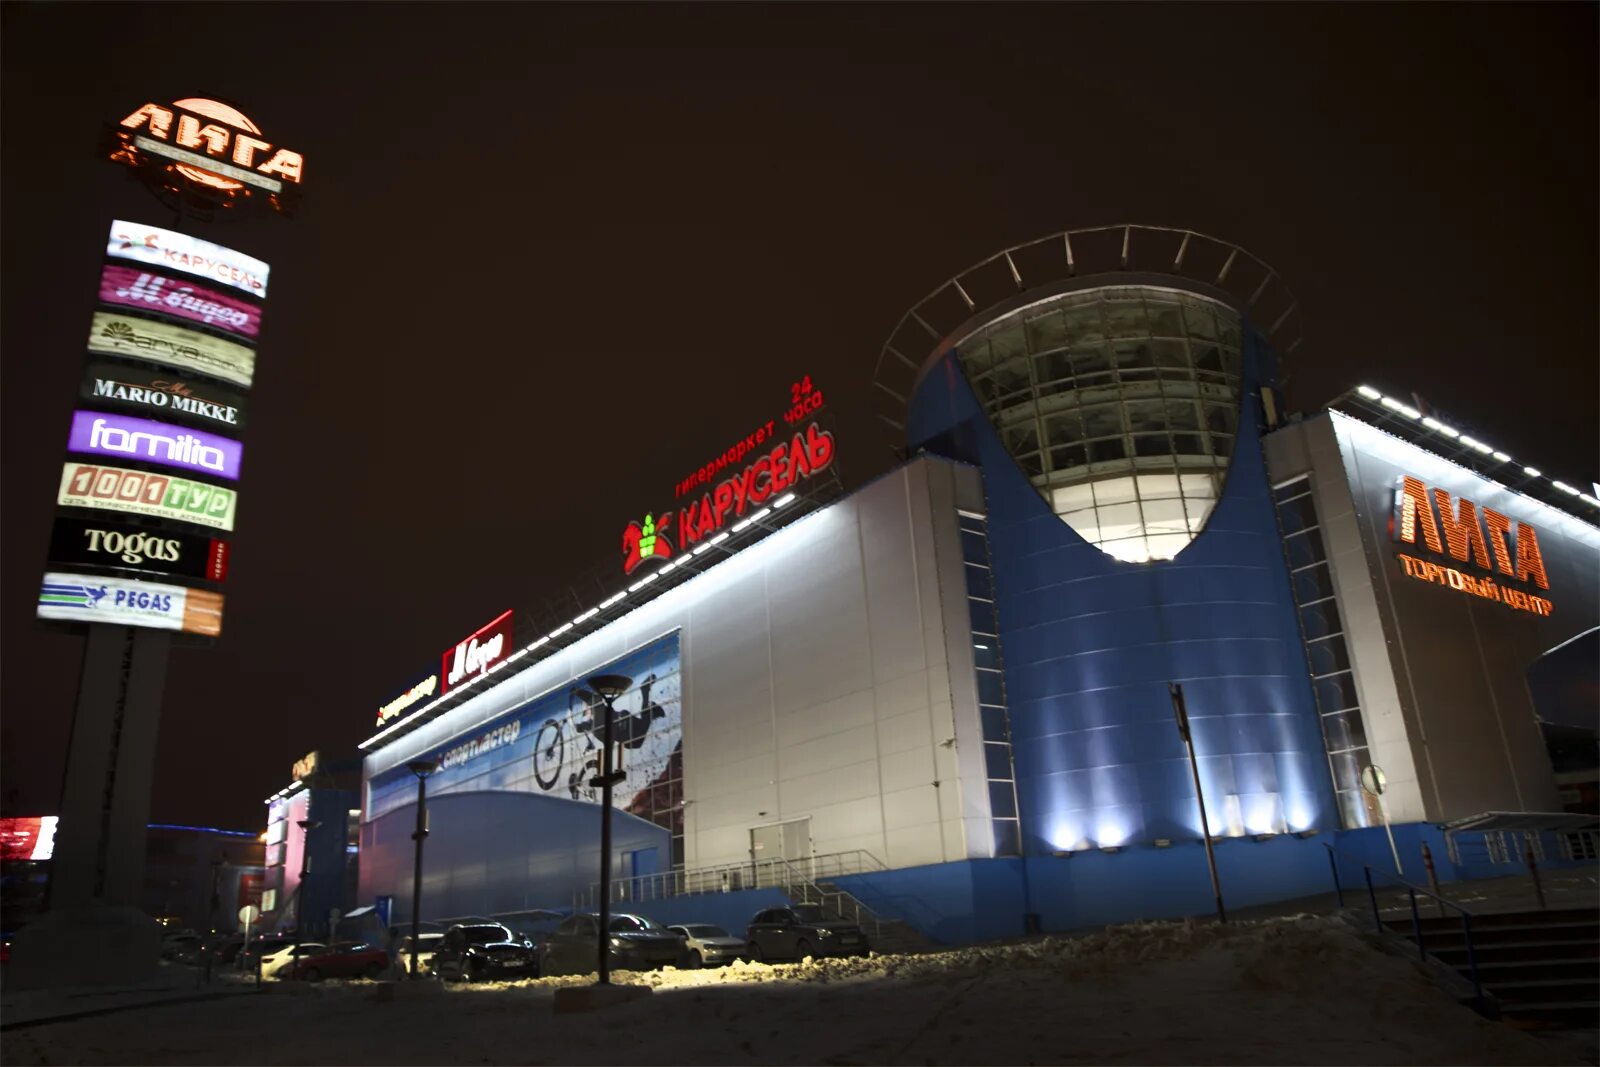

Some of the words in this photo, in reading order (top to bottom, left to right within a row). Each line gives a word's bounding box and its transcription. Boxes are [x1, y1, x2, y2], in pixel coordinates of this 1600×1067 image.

[120, 103, 303, 183] ЛИГА
[164, 248, 263, 289] КАРУСЕЛЬ
[93, 378, 168, 406] MARIO
[171, 395, 238, 424] MIKKE
[791, 375, 813, 403] 24
[90, 419, 224, 472] familia
[675, 420, 775, 497] гипермаркет
[678, 422, 834, 549] КАРУСЕЛЬ
[1401, 475, 1549, 590] ЛИГА
[115, 589, 171, 612] PEGAS
[1399, 552, 1501, 602] ТОРГОВЫЙ
[1500, 586, 1553, 617] ЦЕНТР
